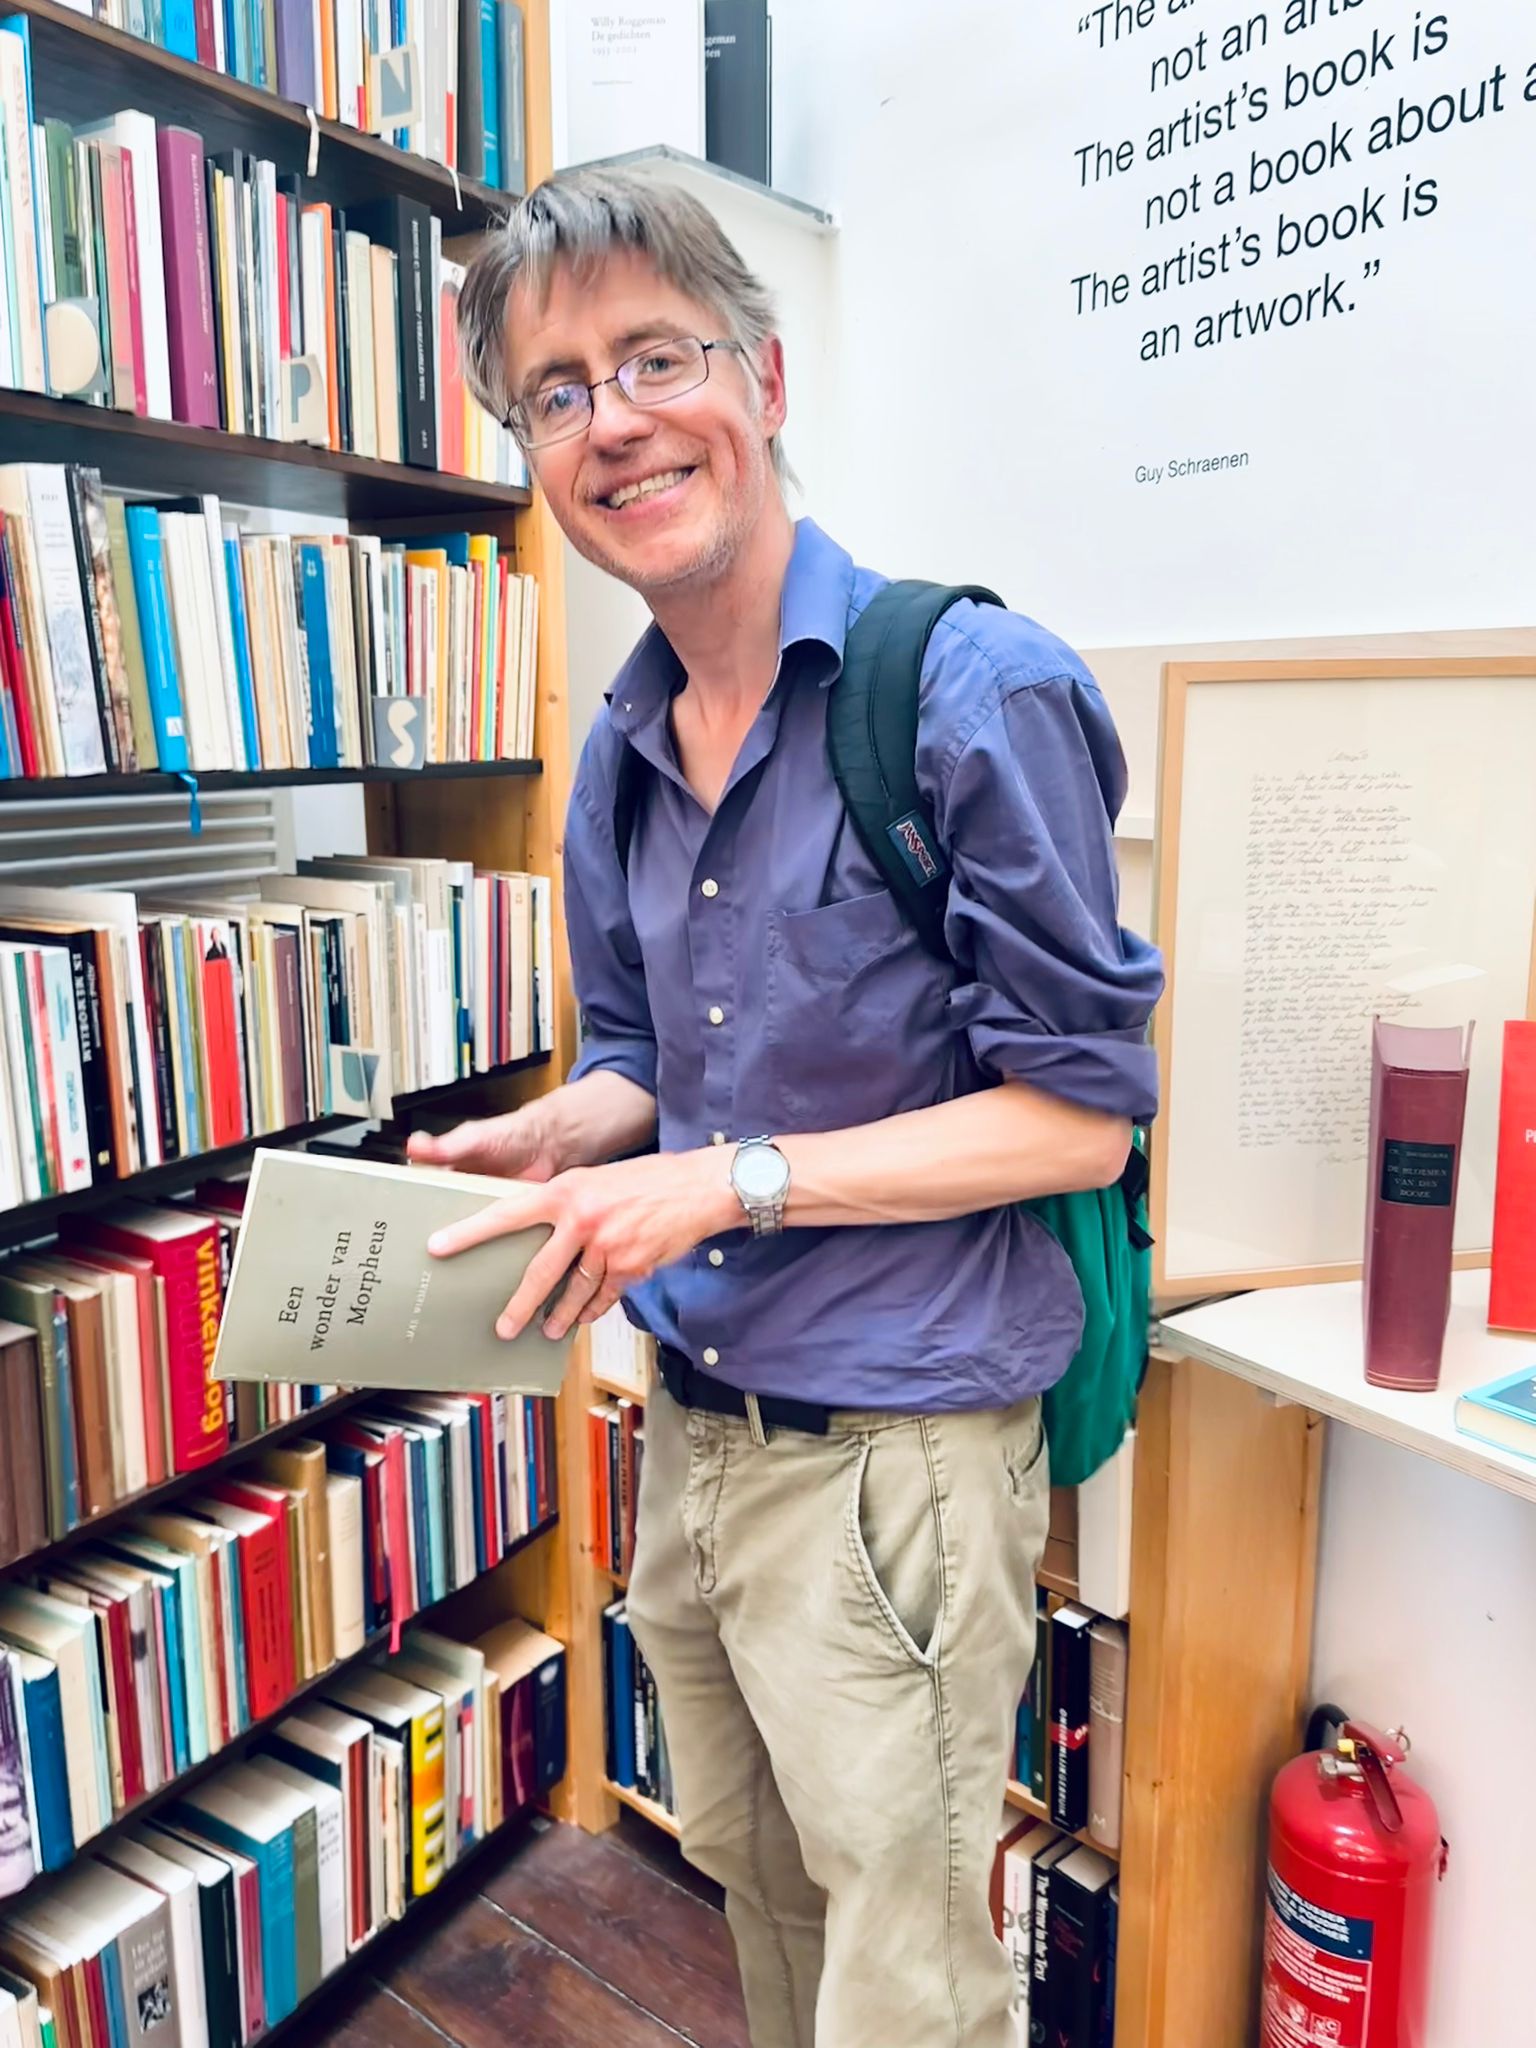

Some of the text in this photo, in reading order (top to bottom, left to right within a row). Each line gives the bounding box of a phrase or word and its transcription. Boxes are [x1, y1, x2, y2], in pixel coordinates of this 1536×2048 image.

[591, 16, 667, 29] Willy Roggeman
[591, 29, 652, 43] De gedichten
[1150, 31, 1208, 93] not
[1221, 14, 1267, 61] an
[1074, 11, 1448, 187] The artist’s book is
[1146, 173, 1202, 229] not
[1213, 171, 1235, 206] a
[1249, 116, 1353, 195] book
[1367, 64, 1507, 155] about
[1070, 173, 1438, 315] The artist’s book is
[1140, 258, 1381, 362] an artwork.”
[1135, 453, 1249, 485] Guy Schraenen
[387, 699, 419, 770] S
[1525, 1128, 1536, 1144] P
[278, 1286, 305, 1324] Een
[310, 1231, 352, 1352] wonder van
[346, 1220, 388, 1326] Morpheus
[1034, 1874, 1050, 1982] The Mirror in the Text
